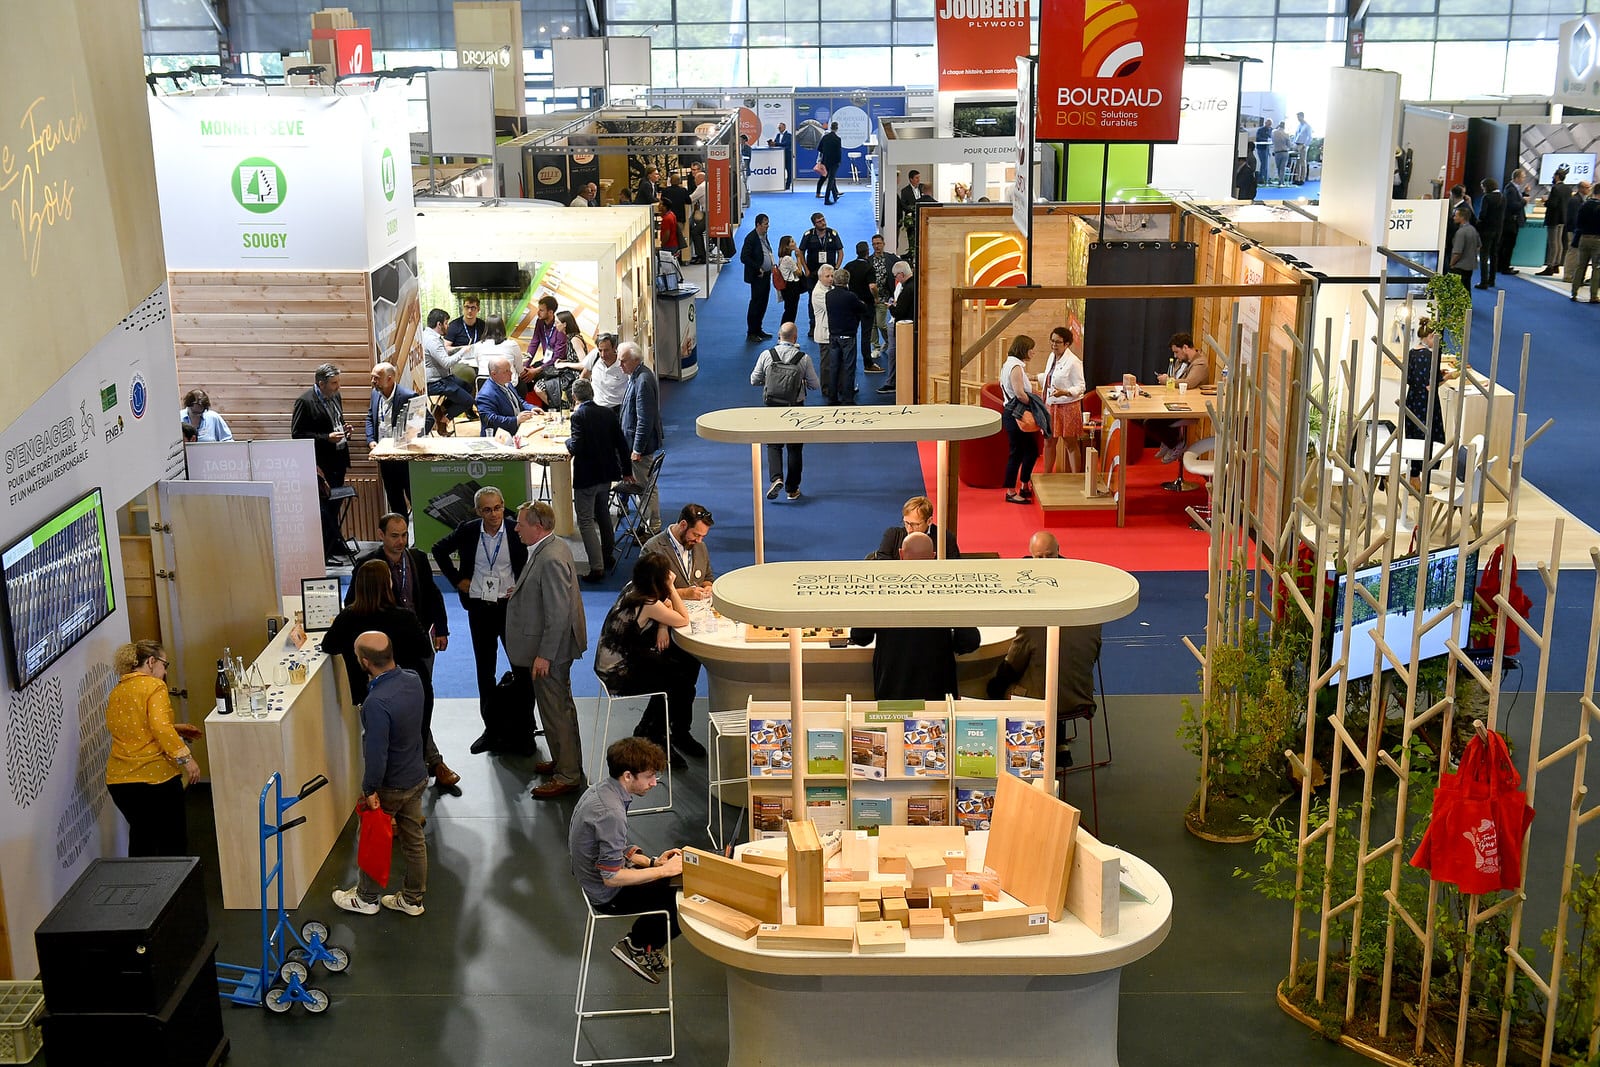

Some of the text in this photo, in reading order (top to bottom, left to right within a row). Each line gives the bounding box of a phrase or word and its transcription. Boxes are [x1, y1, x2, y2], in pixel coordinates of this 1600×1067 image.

[940, 0, 1026, 19] JOUBERT
[462, 50, 498, 64] DROUIN
[1058, 88, 1162, 106] BOURDAUD
[20, 73, 88, 174] French
[1056, 110, 1138, 126] BOIS Solutions
[12, 164, 74, 277] Bois
[242, 232, 287, 248] SOUGY
[789, 416, 881, 430] Bois
[5, 416, 76, 474] S'ENGAGER
[8, 472, 25, 492] POUR
[26, 466, 36, 482] UNE
[54, 442, 78, 464] DURABLE
[54, 449, 88, 478] RESPONSABLE
[796, 574, 1002, 584] S'ENGAGER
